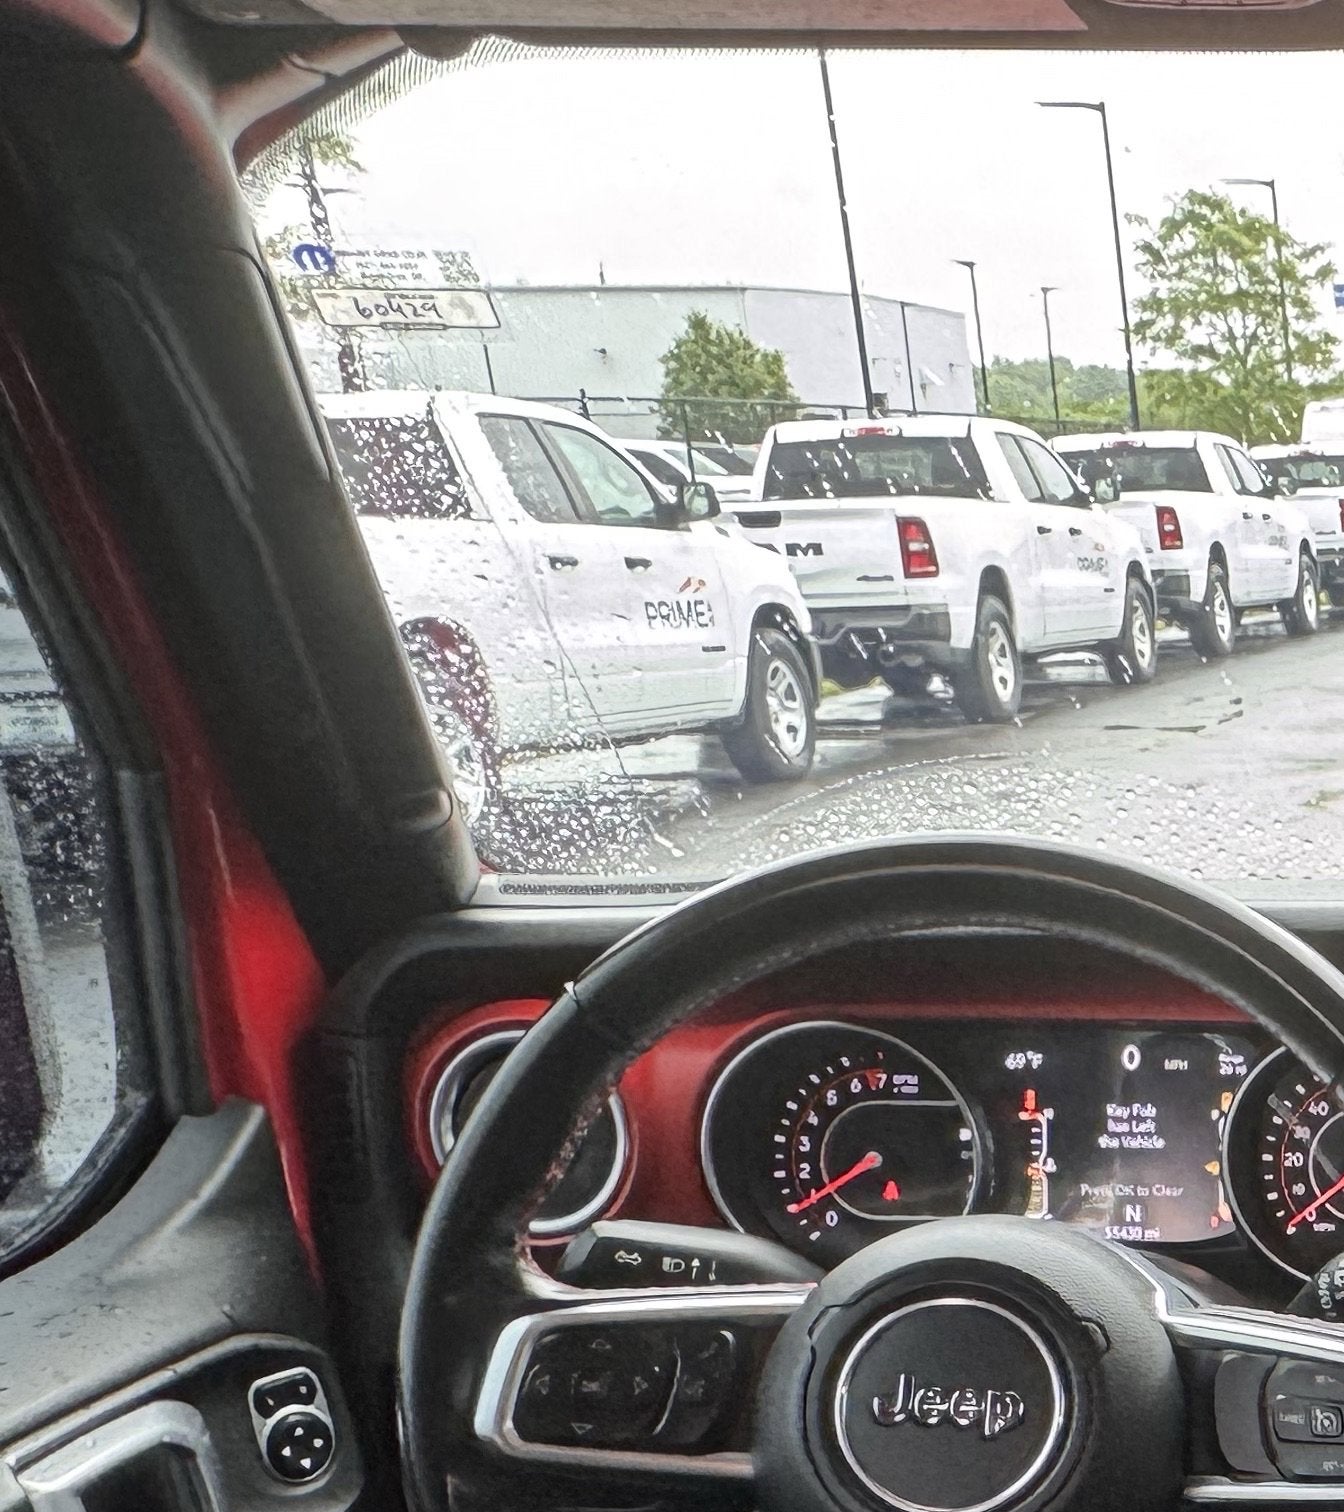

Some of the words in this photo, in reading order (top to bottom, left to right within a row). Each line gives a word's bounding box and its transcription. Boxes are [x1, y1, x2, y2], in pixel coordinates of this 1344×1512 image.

[1120, 1043, 1142, 1072] 0
[1283, 1151, 1304, 1168] 20
[799, 1162, 811, 1180] 2
[825, 1210, 839, 1228] 0
[1124, 1203, 1142, 1223] N
[871, 1372, 1026, 1440] Jeep
